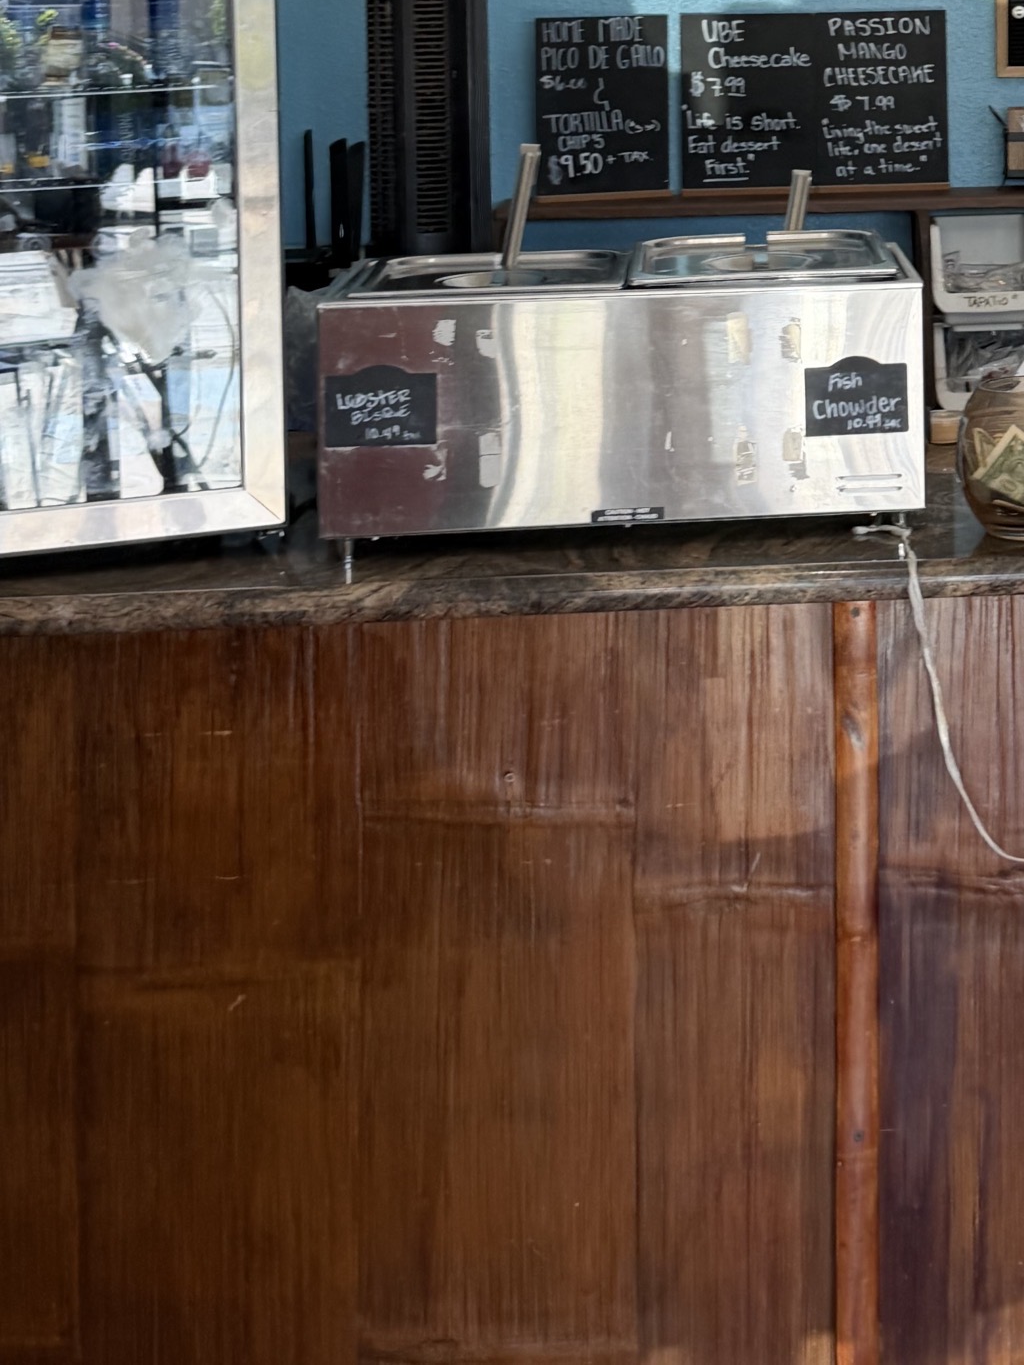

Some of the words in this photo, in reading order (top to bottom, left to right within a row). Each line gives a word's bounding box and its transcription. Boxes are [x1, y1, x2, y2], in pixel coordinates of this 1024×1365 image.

[701, 19, 745, 43] UBE
[828, 16, 931, 37] PASSION
[541, 47, 579, 71] PICO
[588, 45, 610, 69] DE
[708, 47, 812, 69] Cheesecake
[837, 43, 907, 61] MANGO
[823, 64, 935, 87] CHEESECAKE
[688, 135, 716, 154] Eat
[720, 136, 781, 152] dessert
[828, 372, 863, 392] Fish
[813, 397, 900, 417] Chowder
